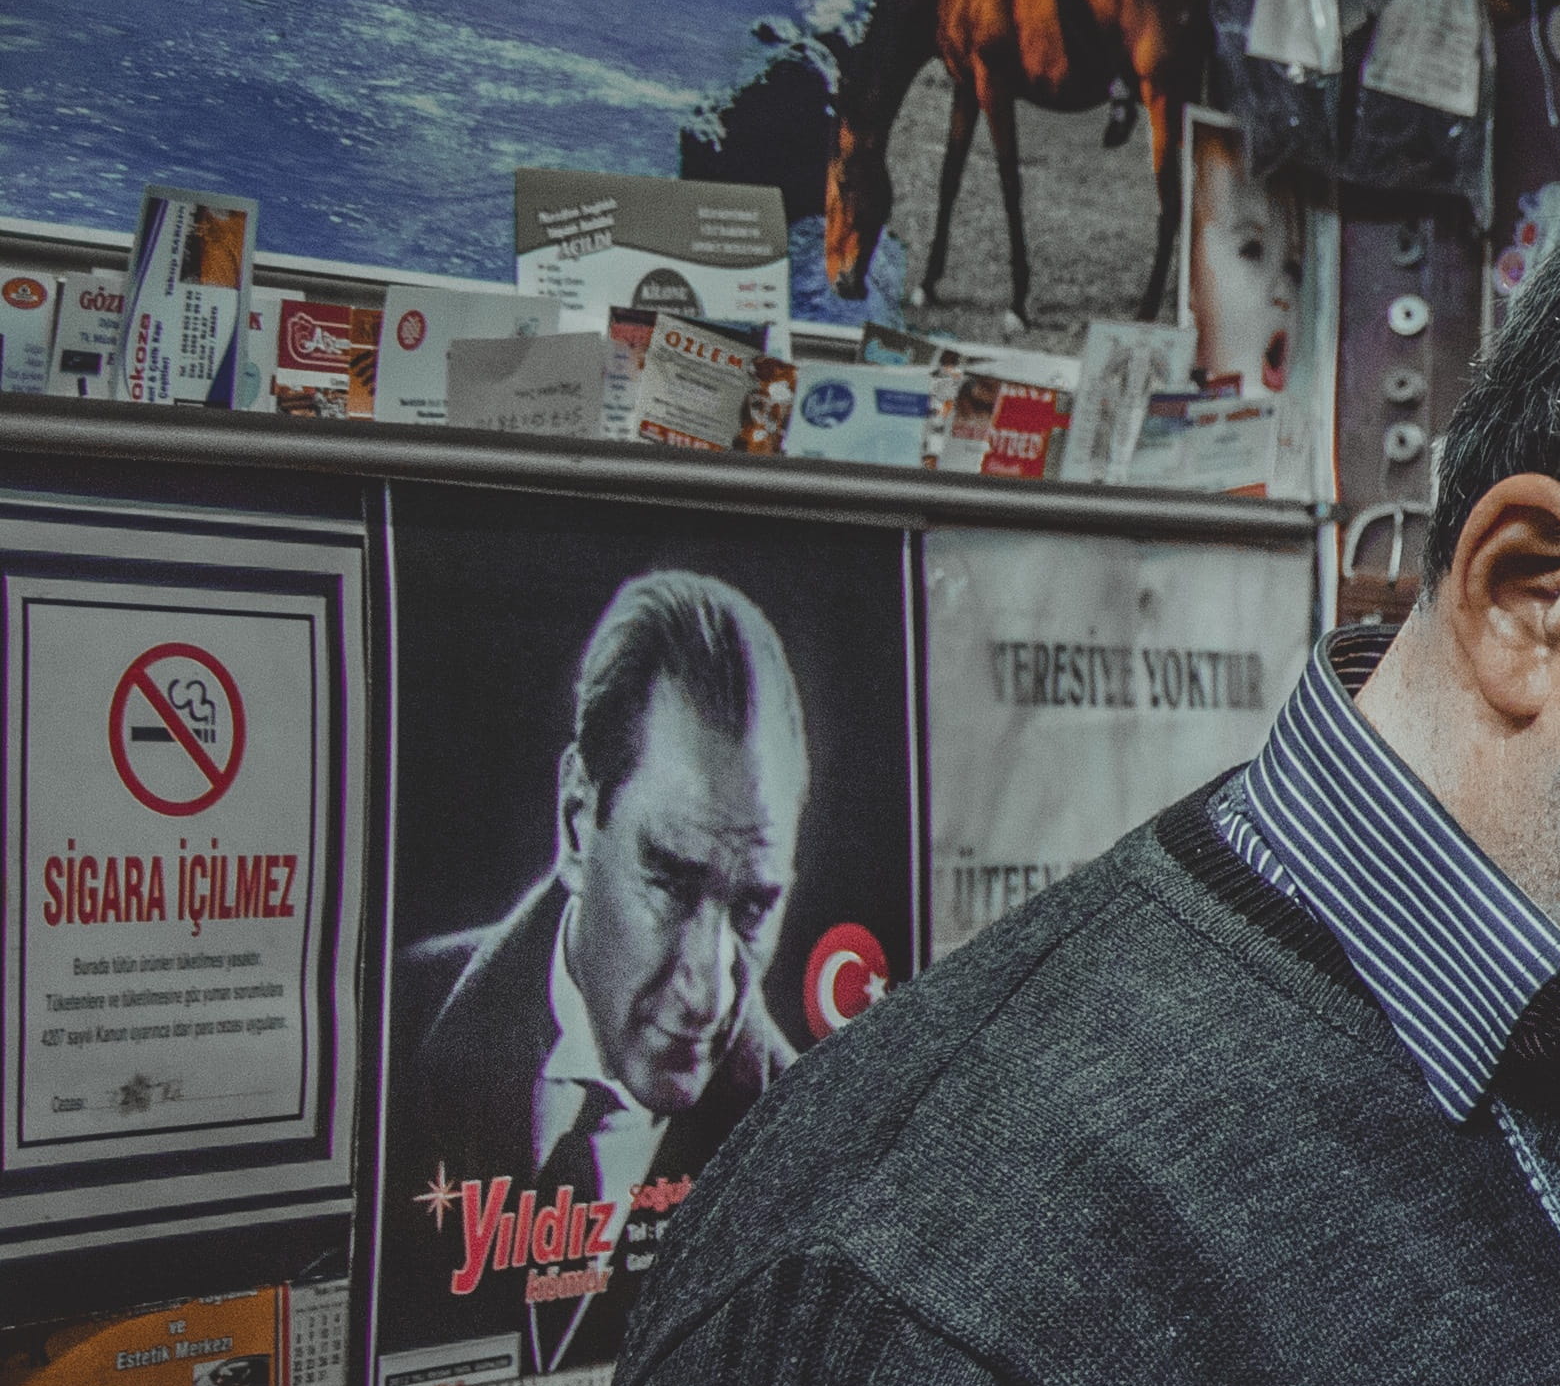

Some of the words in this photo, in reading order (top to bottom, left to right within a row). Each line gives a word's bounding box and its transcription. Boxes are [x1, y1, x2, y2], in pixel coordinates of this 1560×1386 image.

[43, 838, 167, 927] SİGARA
[177, 837, 298, 937] İÇİLMEZ
[168, 1320, 187, 1335] ve
[115, 1345, 171, 1372] Estetik
[174, 1336, 234, 1361] Merkezi
